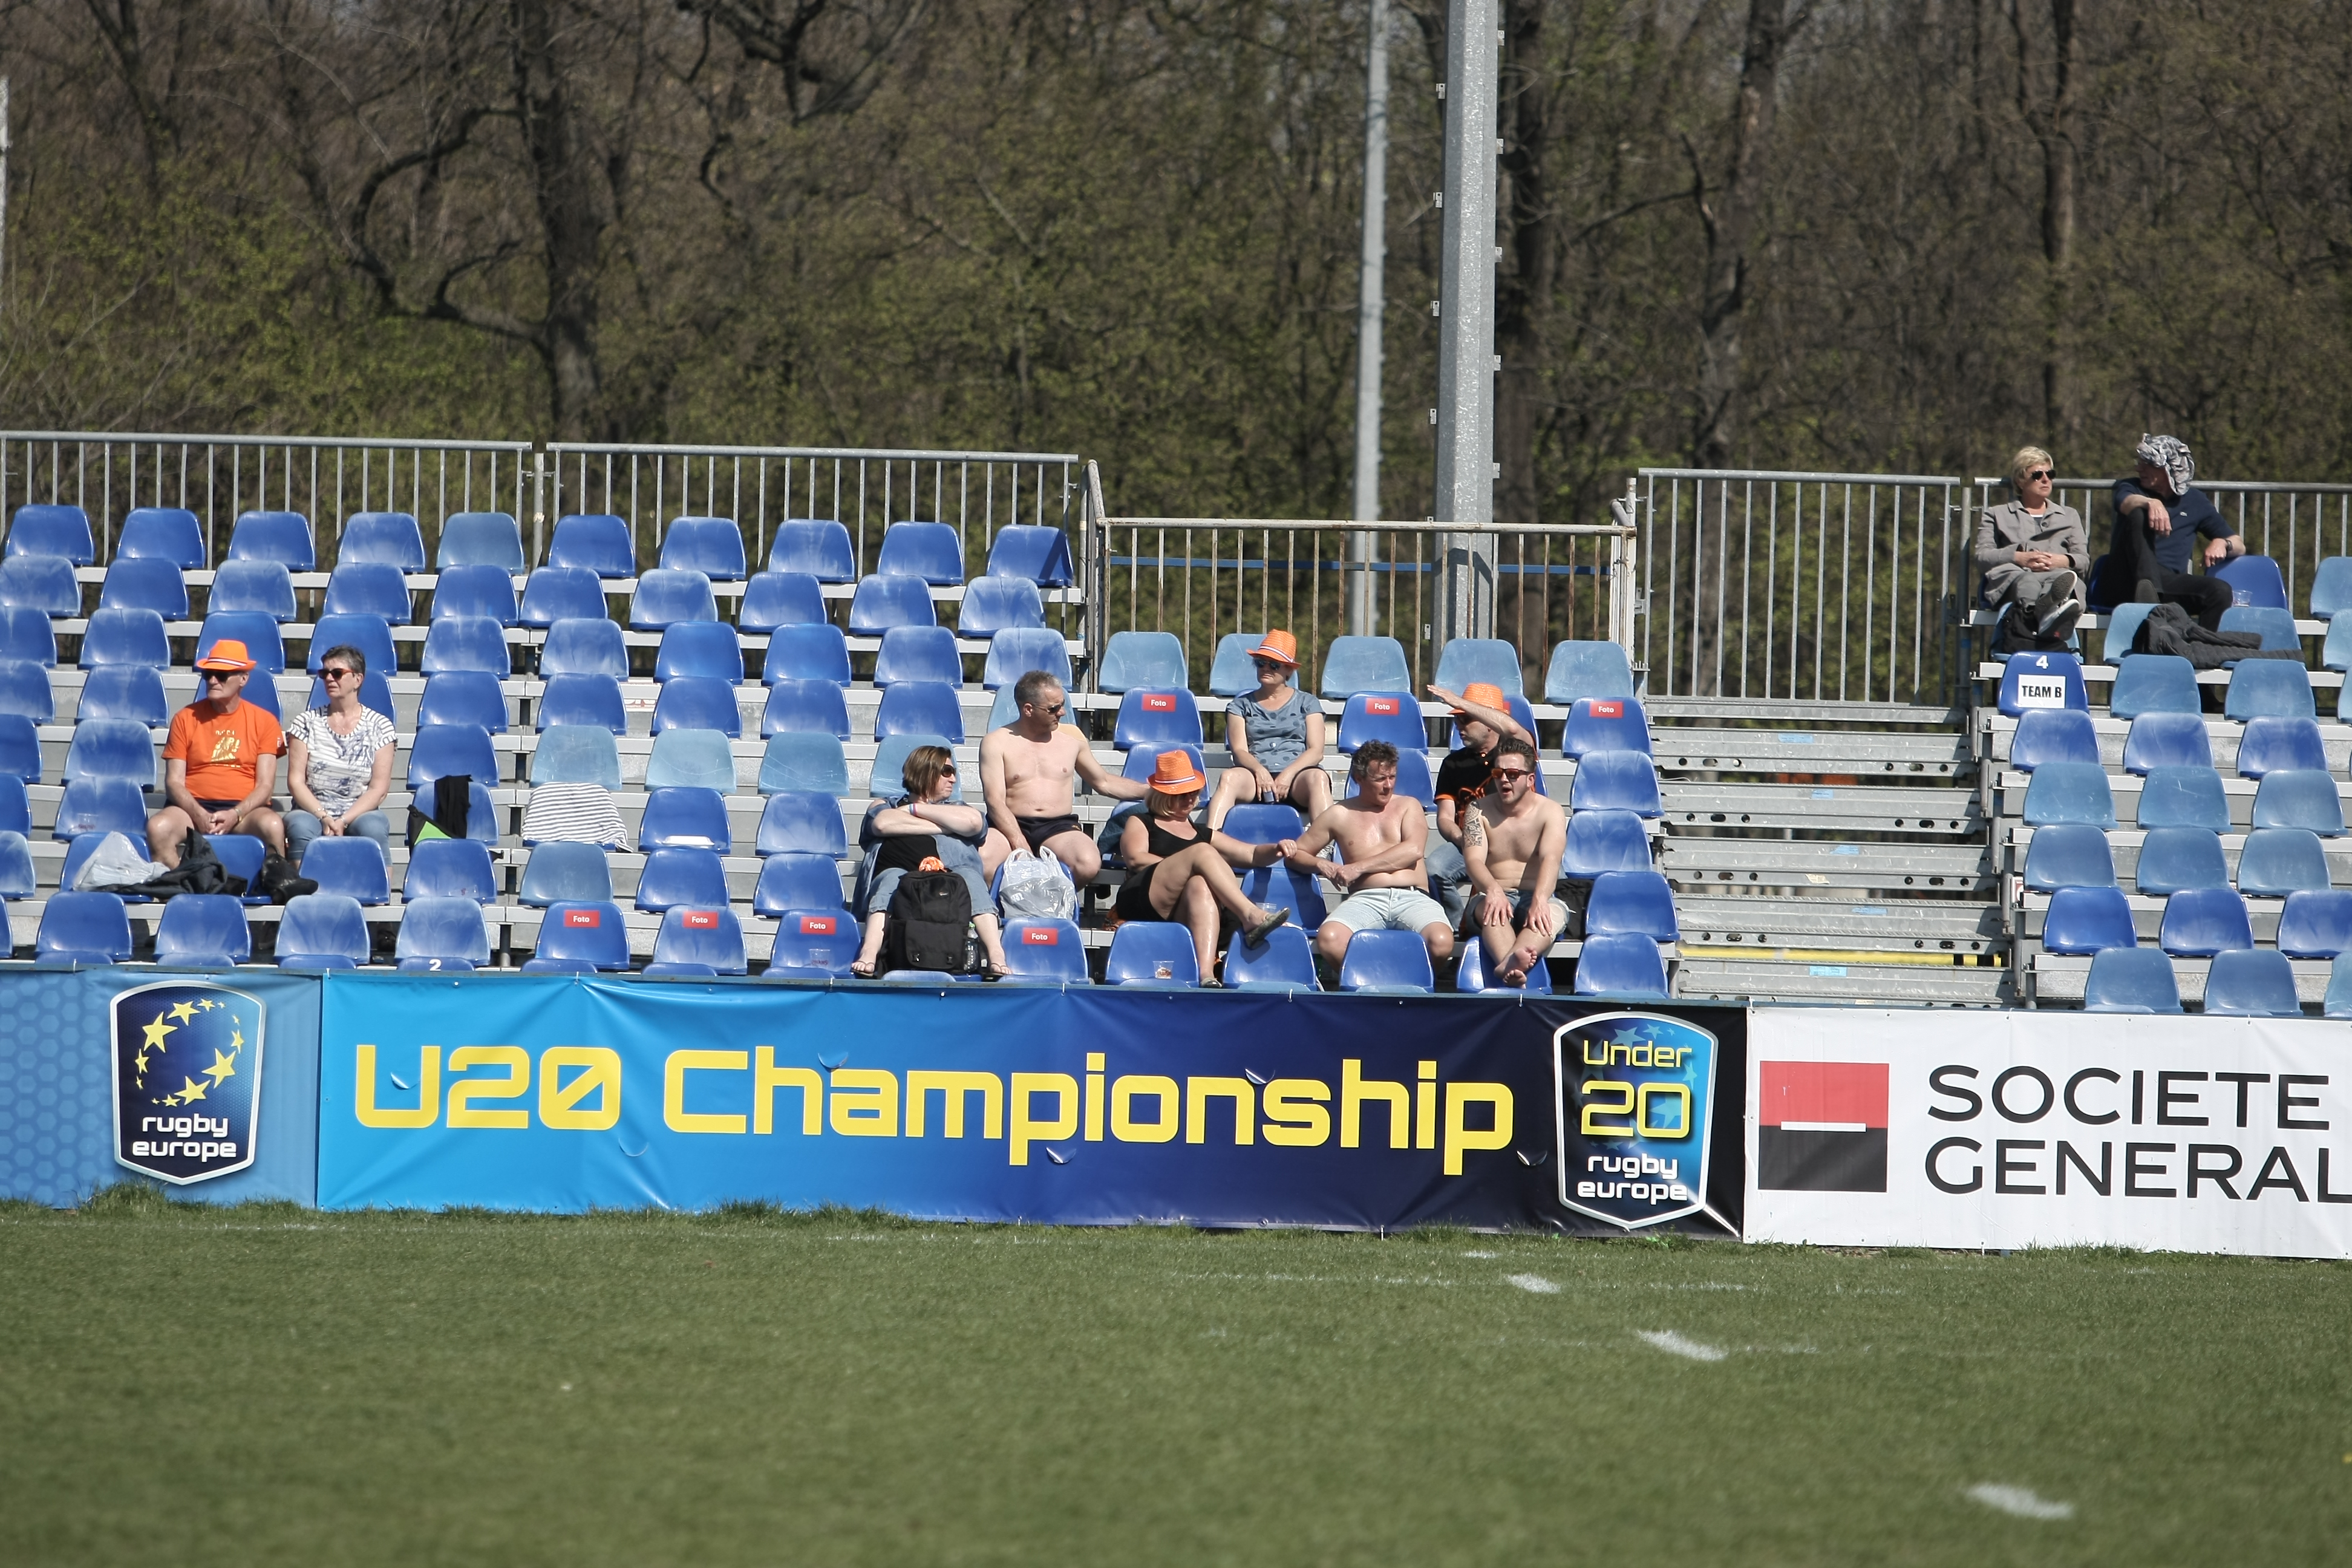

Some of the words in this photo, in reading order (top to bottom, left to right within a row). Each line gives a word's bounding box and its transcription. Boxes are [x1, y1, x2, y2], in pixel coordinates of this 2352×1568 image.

[2036, 655, 2050, 670] 4
[2021, 685, 2051, 698] TEAM
[2054, 687, 2062, 698] B
[429, 959, 442, 972] 2
[1583, 1040, 1692, 1067] Under
[356, 1045, 621, 1130] U20
[664, 1046, 1514, 1175] Championship
[1581, 1080, 1691, 1138] 20
[1927, 1064, 2330, 1131] SOCIETE
[142, 1113, 229, 1138] rugby
[132, 1139, 237, 1162] europe
[1587, 1153, 1678, 1180] rugby
[1576, 1181, 1688, 1205] europe
